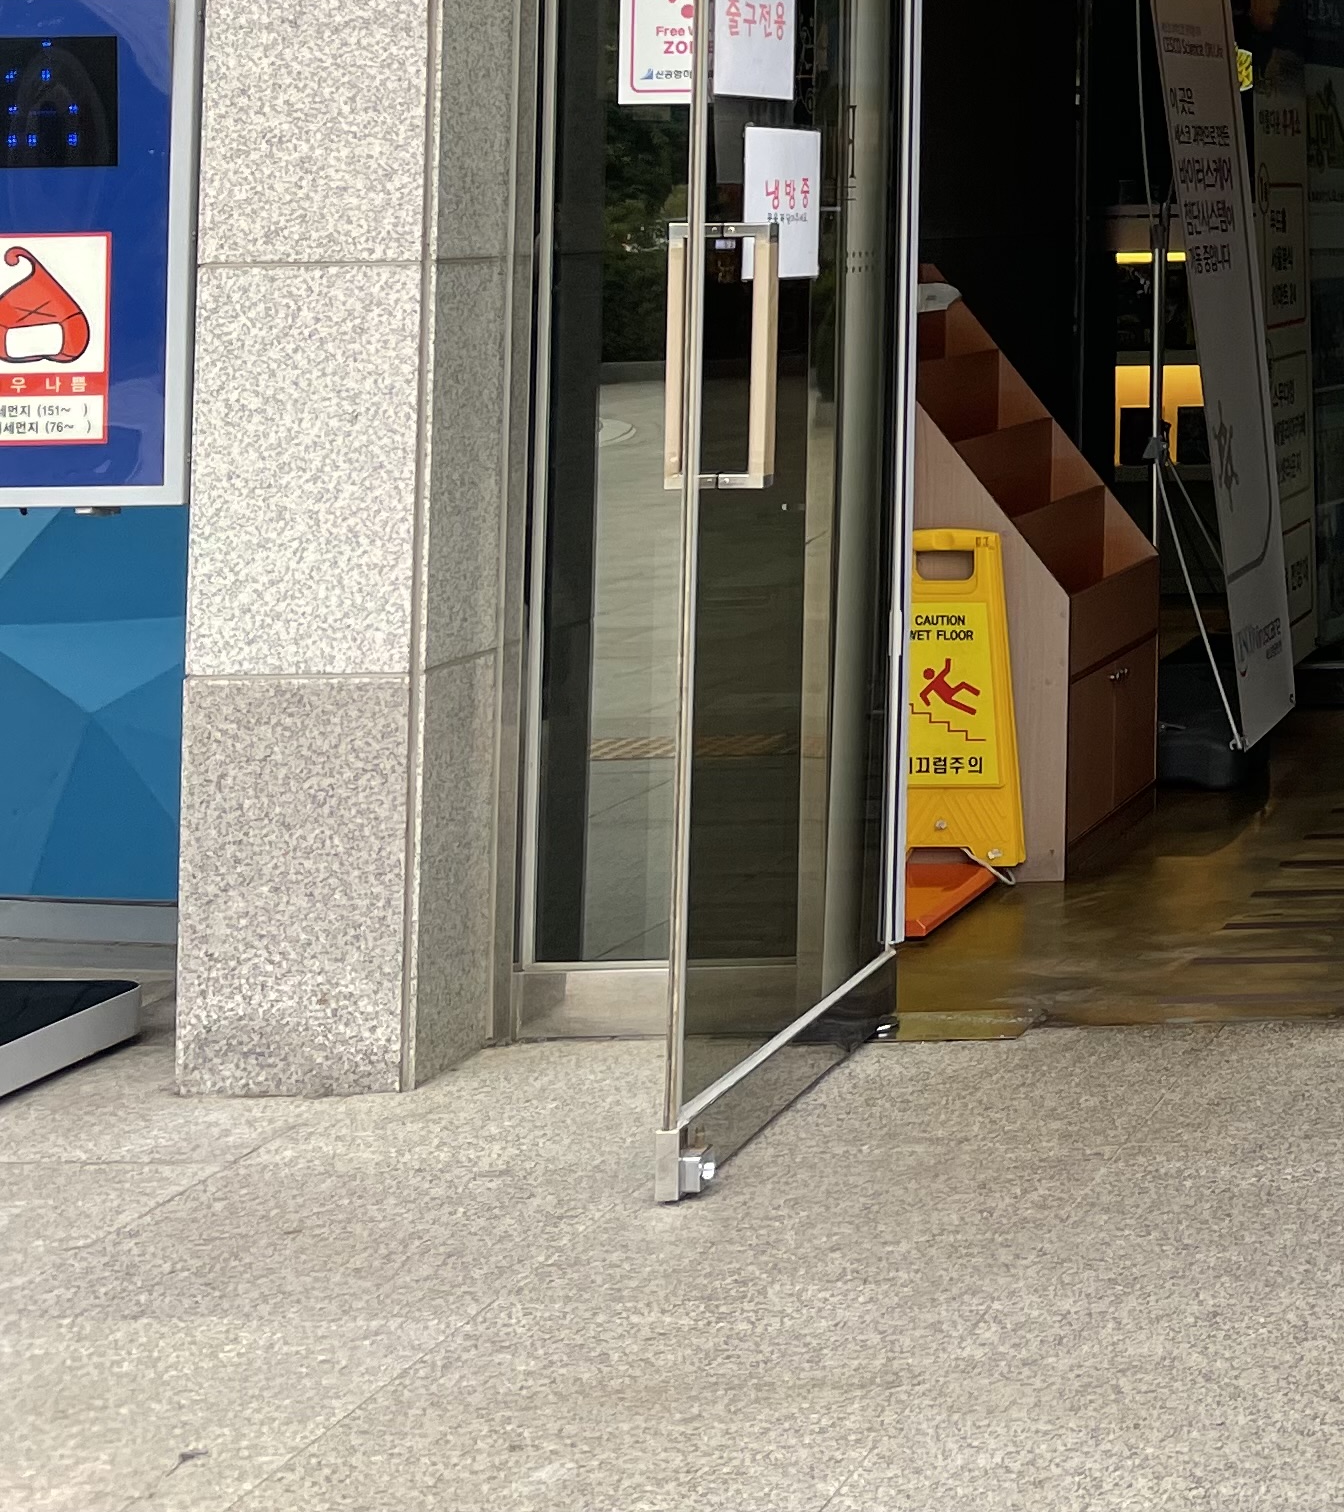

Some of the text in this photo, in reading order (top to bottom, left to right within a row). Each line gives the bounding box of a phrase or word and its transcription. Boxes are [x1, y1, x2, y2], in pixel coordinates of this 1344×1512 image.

[656, 26, 686, 37] Free
[765, 177, 810, 210] 냉방중
[915, 615, 966, 626] CAUTION
[936, 629, 974, 641] FLOOR
